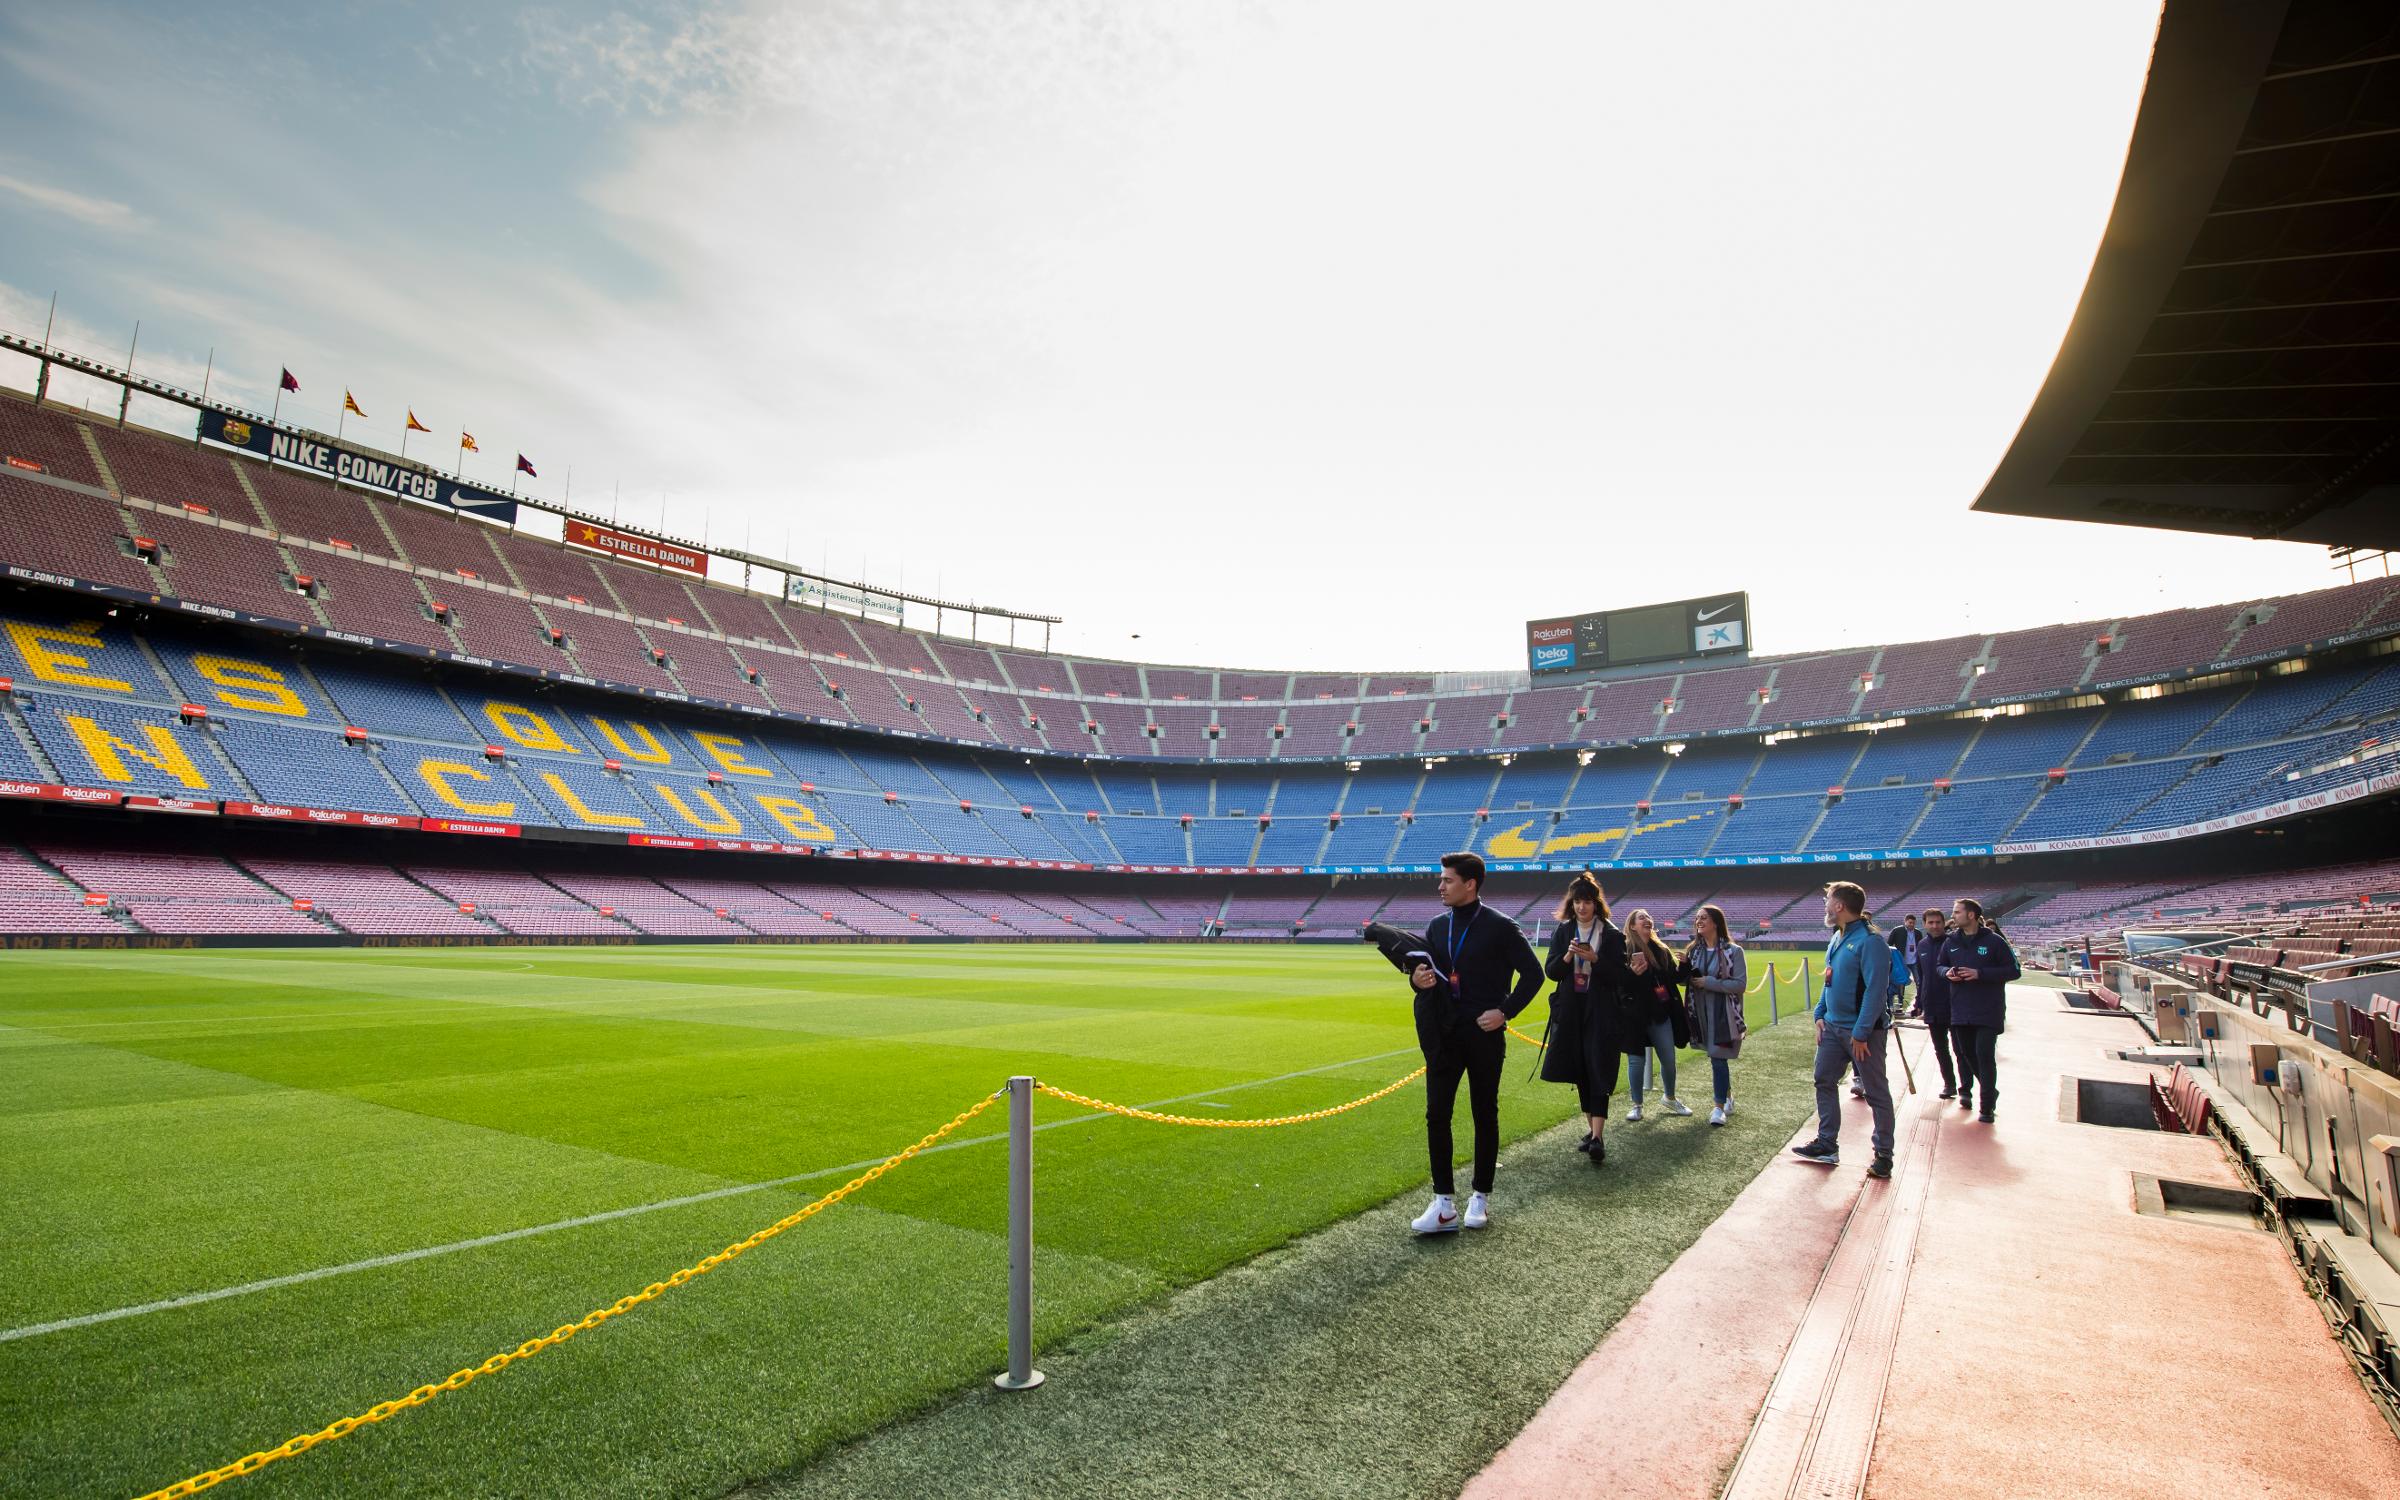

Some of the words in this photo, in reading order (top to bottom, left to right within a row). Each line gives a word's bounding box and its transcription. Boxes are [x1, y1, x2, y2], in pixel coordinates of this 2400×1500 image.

[271, 432, 438, 501] NIKE.COM/FCB
[600, 535, 657, 558] ESTRELLA
[659, 549, 695, 568] DAMM
[9, 566, 75, 588] NIKE.COM/FCB
[180, 601, 236, 619] NIKE.COM/FCB
[325, 629, 374, 646] NIKE.COM/FCB
[1533, 627, 1573, 641] Rakuten
[1537, 648, 1569, 660] beko
[450, 653, 493, 667] NIKE.COM/FCB
[2210, 649, 2288, 671] FCBARCELONA.COM
[559, 673, 596, 686] NIKE.COM/FCB
[2096, 671, 2171, 690] FCBARCELONA.COM
[1991, 689, 2061, 705] FCBARCELONA.COM
[1892, 703, 1956, 717] FCBARCELONA.COM
[1802, 715, 1861, 727] FCBARCELONA.COM
[1718, 724, 1773, 736] FCBARCELONA.COM
[485, 701, 773, 778] QUE
[1638, 733, 1690, 743] FCBARCELONA.COM
[62, 788, 111, 800] Rakuten
[2335, 783, 2363, 801] KONAMI
[158, 798, 193, 809] Rakuten
[418, 760, 835, 842] CLUB
[2298, 794, 2326, 810] KONAMI
[252, 804, 292, 816] Rakuten
[309, 809, 347, 821] Rakuten
[2265, 804, 2290, 818] KONAMI
[362, 814, 398, 825] Rakuten
[2235, 812, 2257, 825] KONAMI
[450, 824, 484, 834] ESTRELLA
[485, 826, 506, 836] DAMM
[2205, 819, 2228, 831] KONAMI
[2142, 831, 2170, 842] KONAMI
[2177, 825, 2199, 837] KONAMI
[650, 838, 677, 847] ESTRELLA
[717, 841, 741, 850] Rakuten
[750, 843, 773, 851] Rakuten
[2049, 840, 2090, 850] KONAMI
[2094, 836, 2131, 847] KONAMI
[782, 845, 803, 853] Rakuten
[862, 850, 883, 858] Rakuten
[1884, 850, 1910, 859] beko
[1922, 849, 1948, 858] beko
[1960, 847, 1987, 856] beko
[1993, 844, 2036, 854] KONAMI
[890, 852, 910, 860] Rakuten
[917, 854, 935, 862] Rakuten
[967, 857, 985, 865] Rakuten
[1714, 857, 1736, 865] beko
[1747, 856, 1769, 864] beko
[1780, 855, 1803, 863] beko
[1814, 853, 1837, 862] beko
[1849, 852, 1873, 860] beko
[1495, 863, 1514, 871] beko
[1594, 861, 1613, 869] beko
[1623, 860, 1643, 868] beko
[1683, 858, 1704, 866] beko
[1387, 865, 1405, 873] beko
[77, 937, 128, 949] PRA
